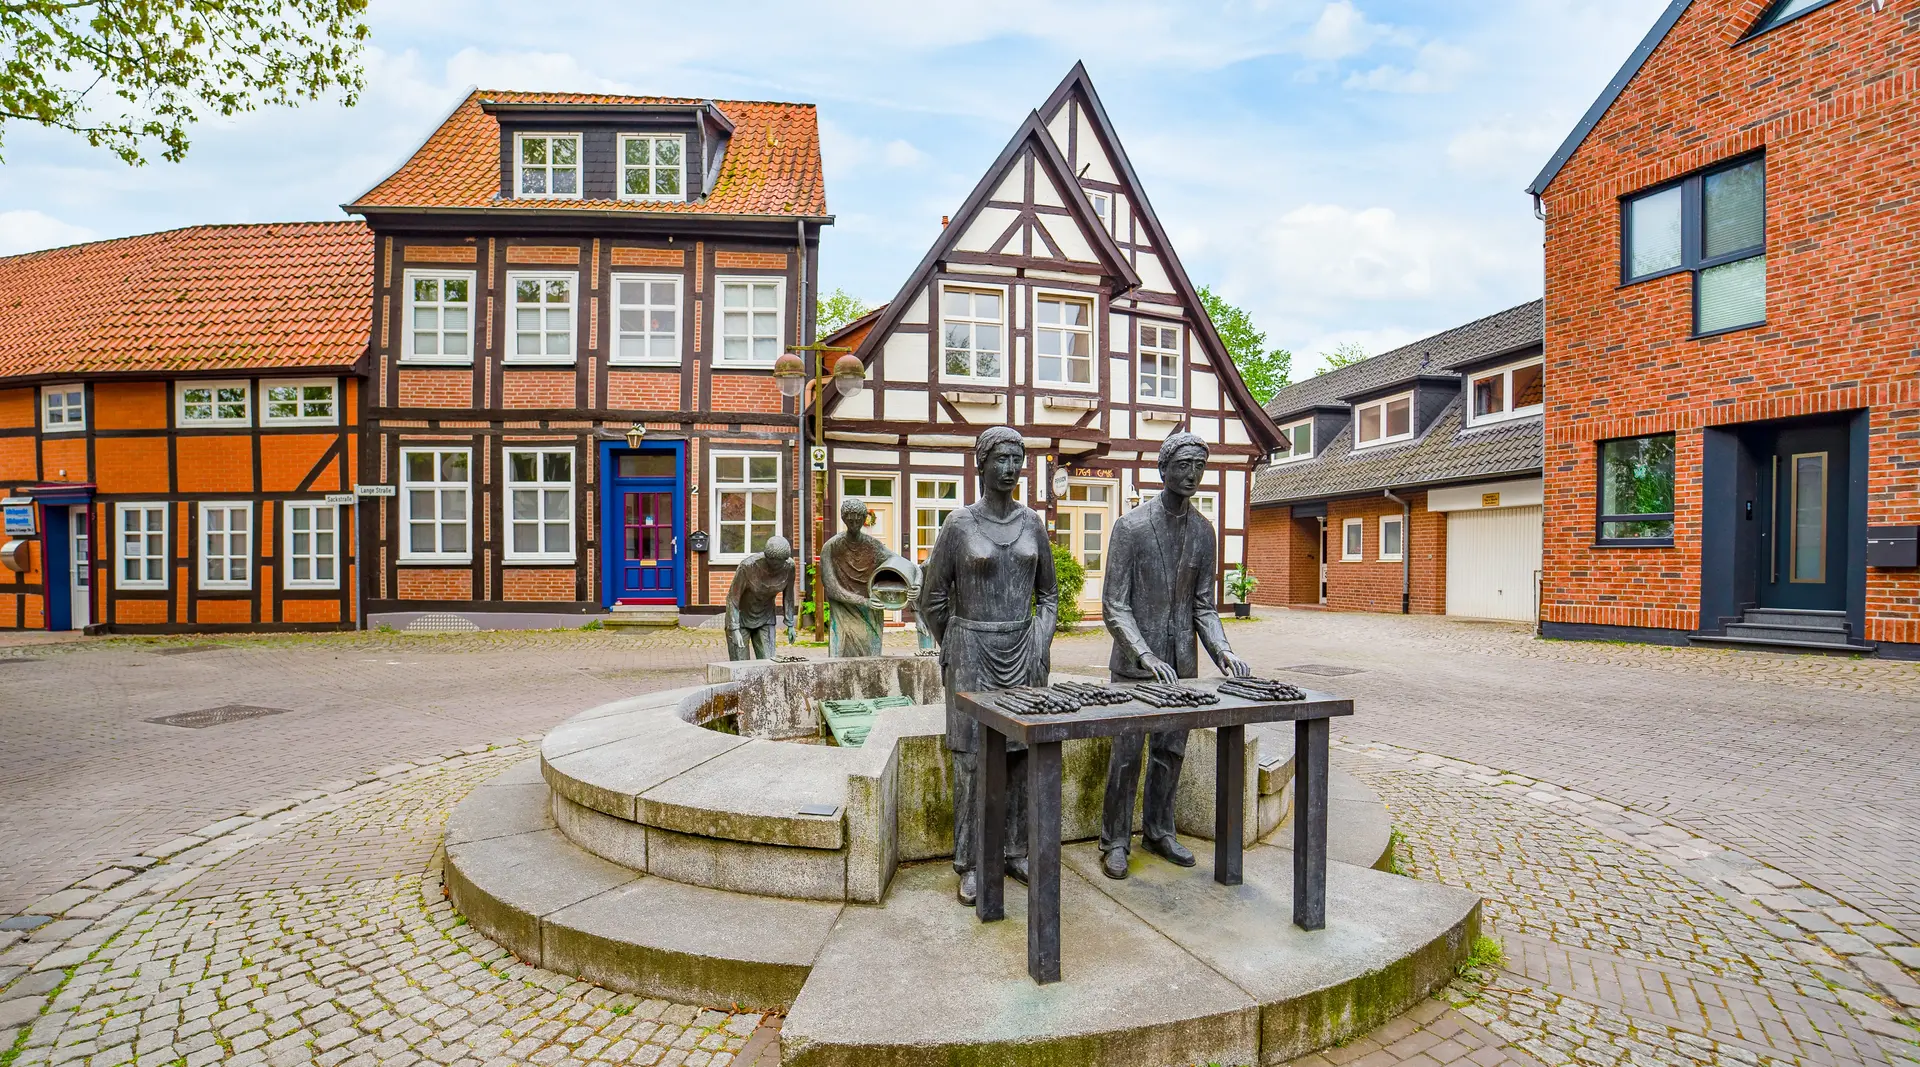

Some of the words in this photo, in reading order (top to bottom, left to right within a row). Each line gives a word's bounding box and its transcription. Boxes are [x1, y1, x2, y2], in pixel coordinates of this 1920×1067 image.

[1075, 468, 1091, 476] 1764
[360, 487, 374, 495] Lange
[691, 485, 699, 494] 2
